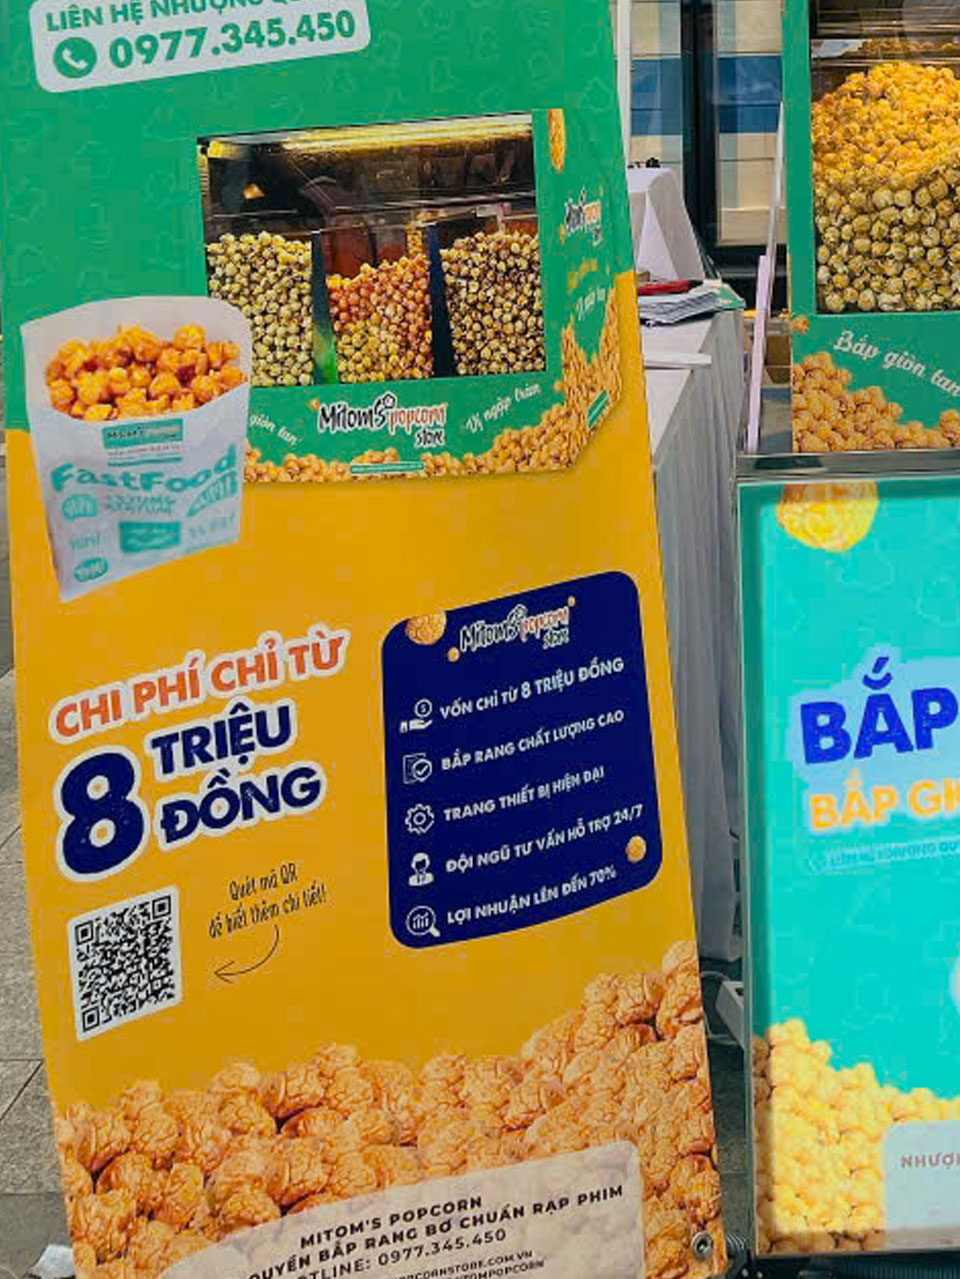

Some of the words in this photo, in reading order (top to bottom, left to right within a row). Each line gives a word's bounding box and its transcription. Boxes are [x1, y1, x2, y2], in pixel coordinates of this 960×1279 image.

[46, 1, 103, 32] LIÊN
[109, 10, 356, 68] 0977.345.450
[55, 689, 122, 735] CHI
[134, 657, 200, 711] PHÍ
[211, 638, 279, 691] CHỈ
[288, 630, 344, 674] TỪ
[440, 697, 472, 719] VỐN
[476, 689, 499, 711] CHỈ
[501, 686, 518, 704] TỪ
[521, 682, 531, 699] 8
[534, 669, 574, 693] TRIỆU
[579, 657, 624, 682] ĐỒNG
[800, 656, 959, 764] BẮP
[151, 701, 292, 777] TRIỆU
[475, 742, 515, 763] RANG
[598, 710, 624, 727] CAO
[60, 750, 144, 876] 8
[159, 765, 322, 843] ĐỒNG
[444, 800, 495, 821] TRANG
[499, 784, 535, 809] THIẾT
[809, 768, 899, 832] BẮP
[446, 853, 473, 873] ĐỘI
[477, 846, 510, 867] NGŨ
[514, 841, 533, 857] TƯ
[536, 829, 565, 851] VẤN
[475, 894, 530, 917] NHUẬN
[300, 1218, 381, 1249] MITOM'S
[390, 1195, 483, 1233] POPCORN
[365, 1228, 418, 1250] RANG
[425, 1220, 452, 1237] BƠ
[532, 1197, 570, 1218] RẠP
[578, 1185, 624, 1206] PHIM
[378, 1228, 507, 1267] 0977.345.450
